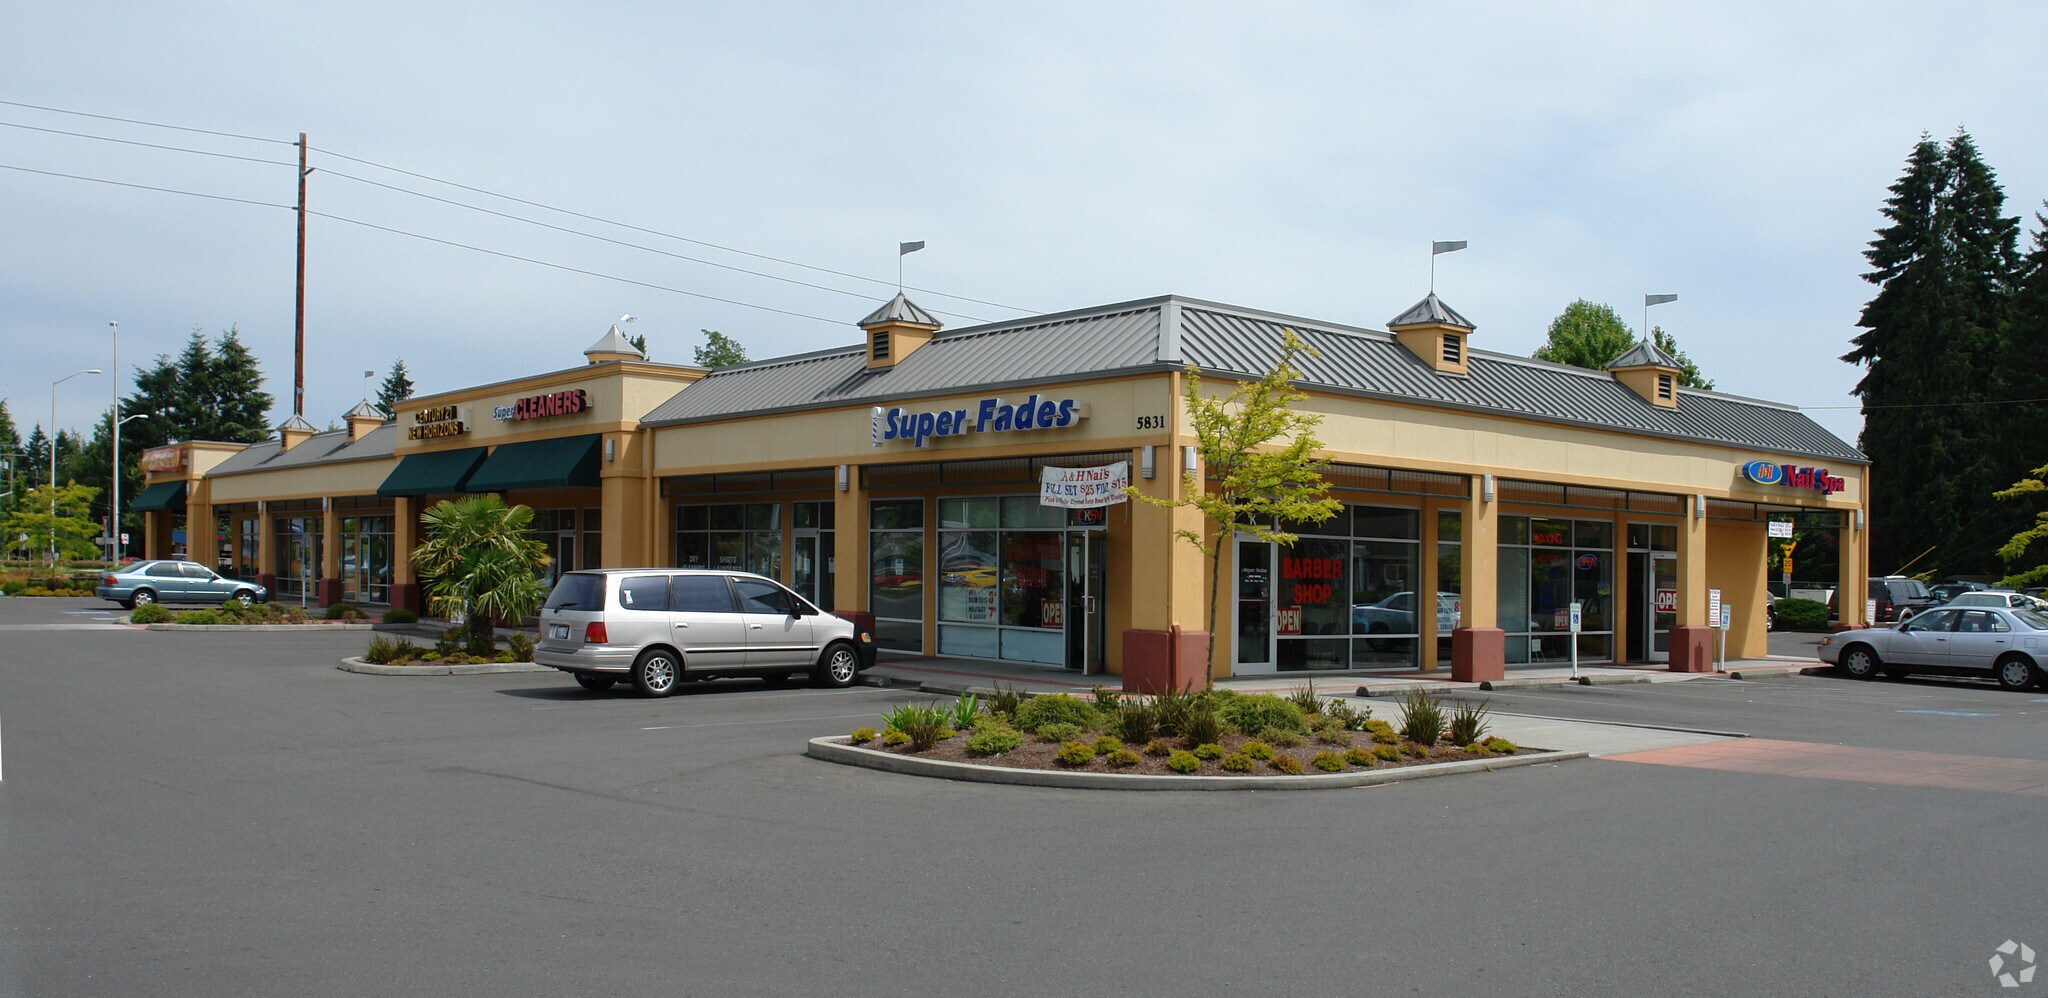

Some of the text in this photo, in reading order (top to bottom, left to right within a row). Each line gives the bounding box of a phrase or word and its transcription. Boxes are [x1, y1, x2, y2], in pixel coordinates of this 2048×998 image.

[493, 389, 582, 422] Super CLEANERS
[415, 407, 445, 424] CENTURY
[884, 394, 1073, 448] Super Fades
[1136, 415, 1165, 430] 5831
[408, 422, 460, 440] NEW HORIZONS
[1075, 470, 1086, 482] H
[1785, 464, 1814, 489] Nail
[1820, 468, 1845, 495] Spa
[1064, 485, 1078, 496] SET
[1080, 483, 1095, 496] $25
[1249, 515, 1257, 526] K
[1532, 532, 1563, 545] WAXING
[1633, 536, 1638, 546] L
[1282, 557, 1343, 579] BARBER
[1293, 583, 1332, 604] SHOP
[1043, 602, 1063, 624] OPE
